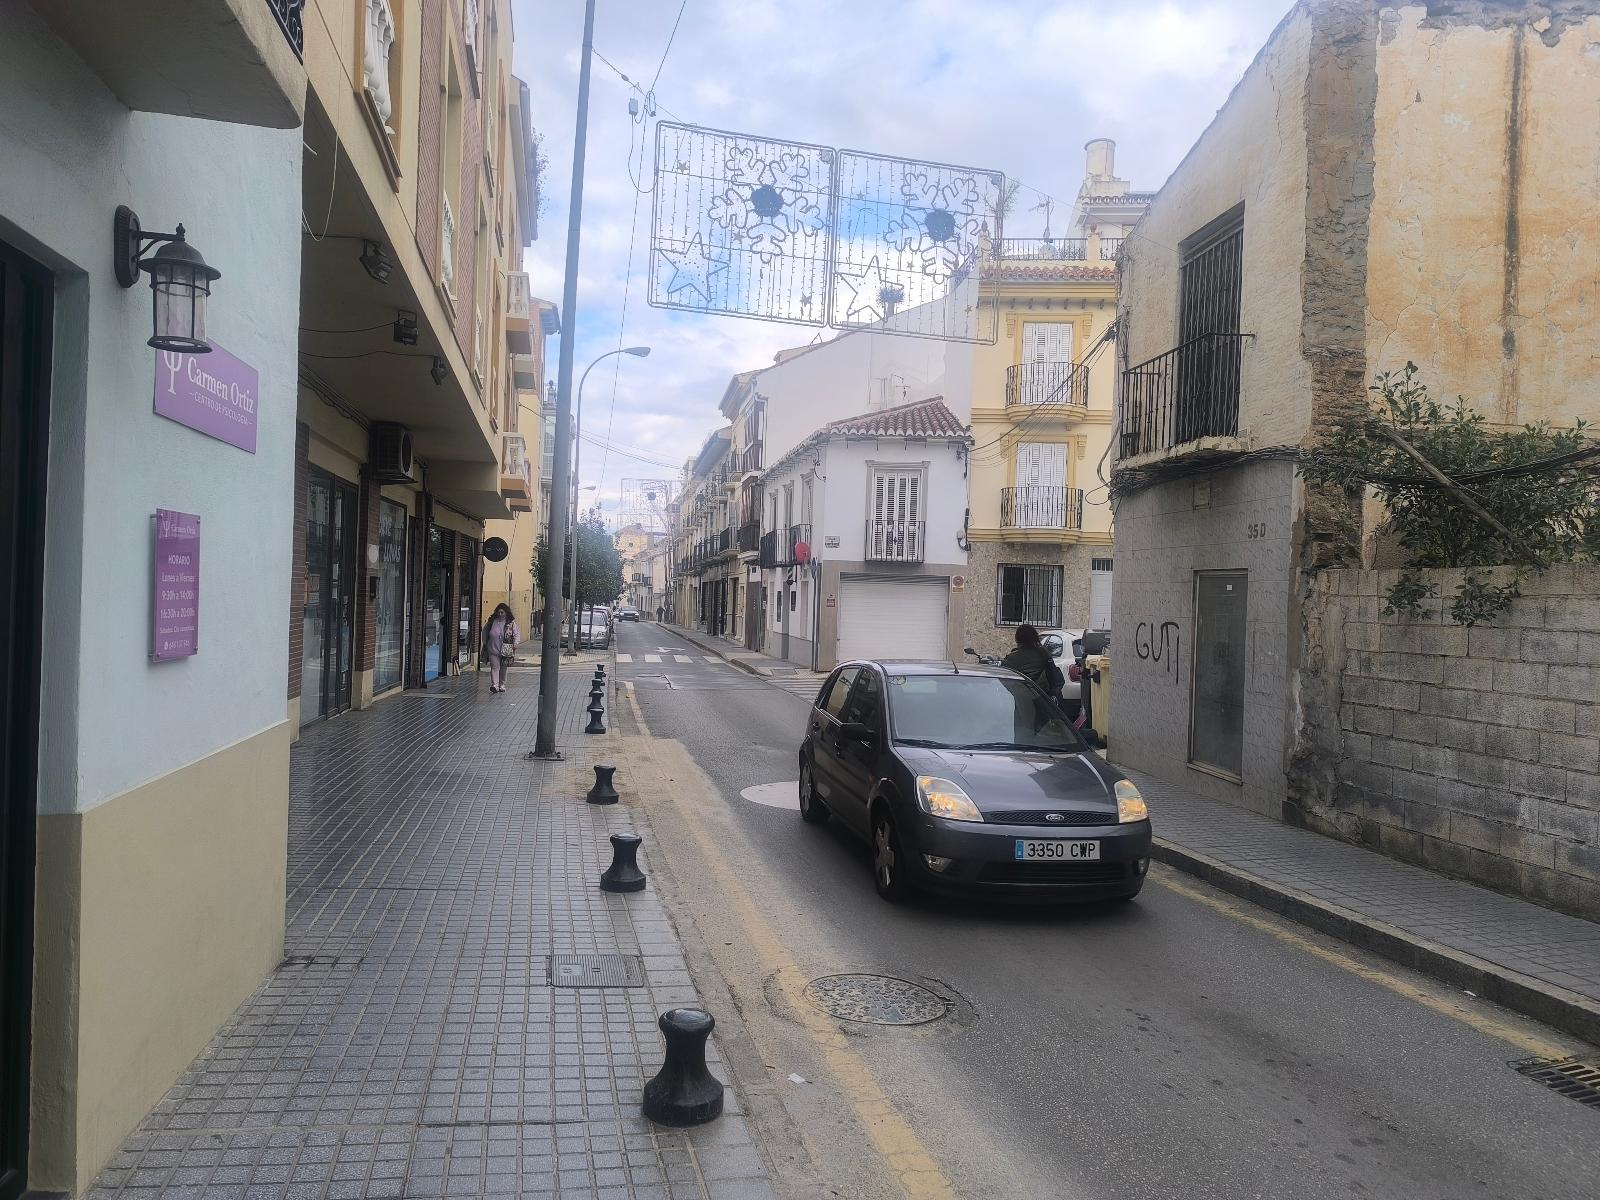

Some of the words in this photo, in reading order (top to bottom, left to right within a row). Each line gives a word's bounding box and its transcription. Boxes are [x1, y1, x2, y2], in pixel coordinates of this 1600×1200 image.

[187, 356, 228, 401] Carmen
[231, 382, 254, 414] Ortiz
[194, 391, 214, 411] CENTRO
[168, 554, 190, 565] HORARIO
[161, 572, 175, 582] Lunes
[1027, 843, 1064, 858] 3350
[1070, 843, 1096, 858] CWP
